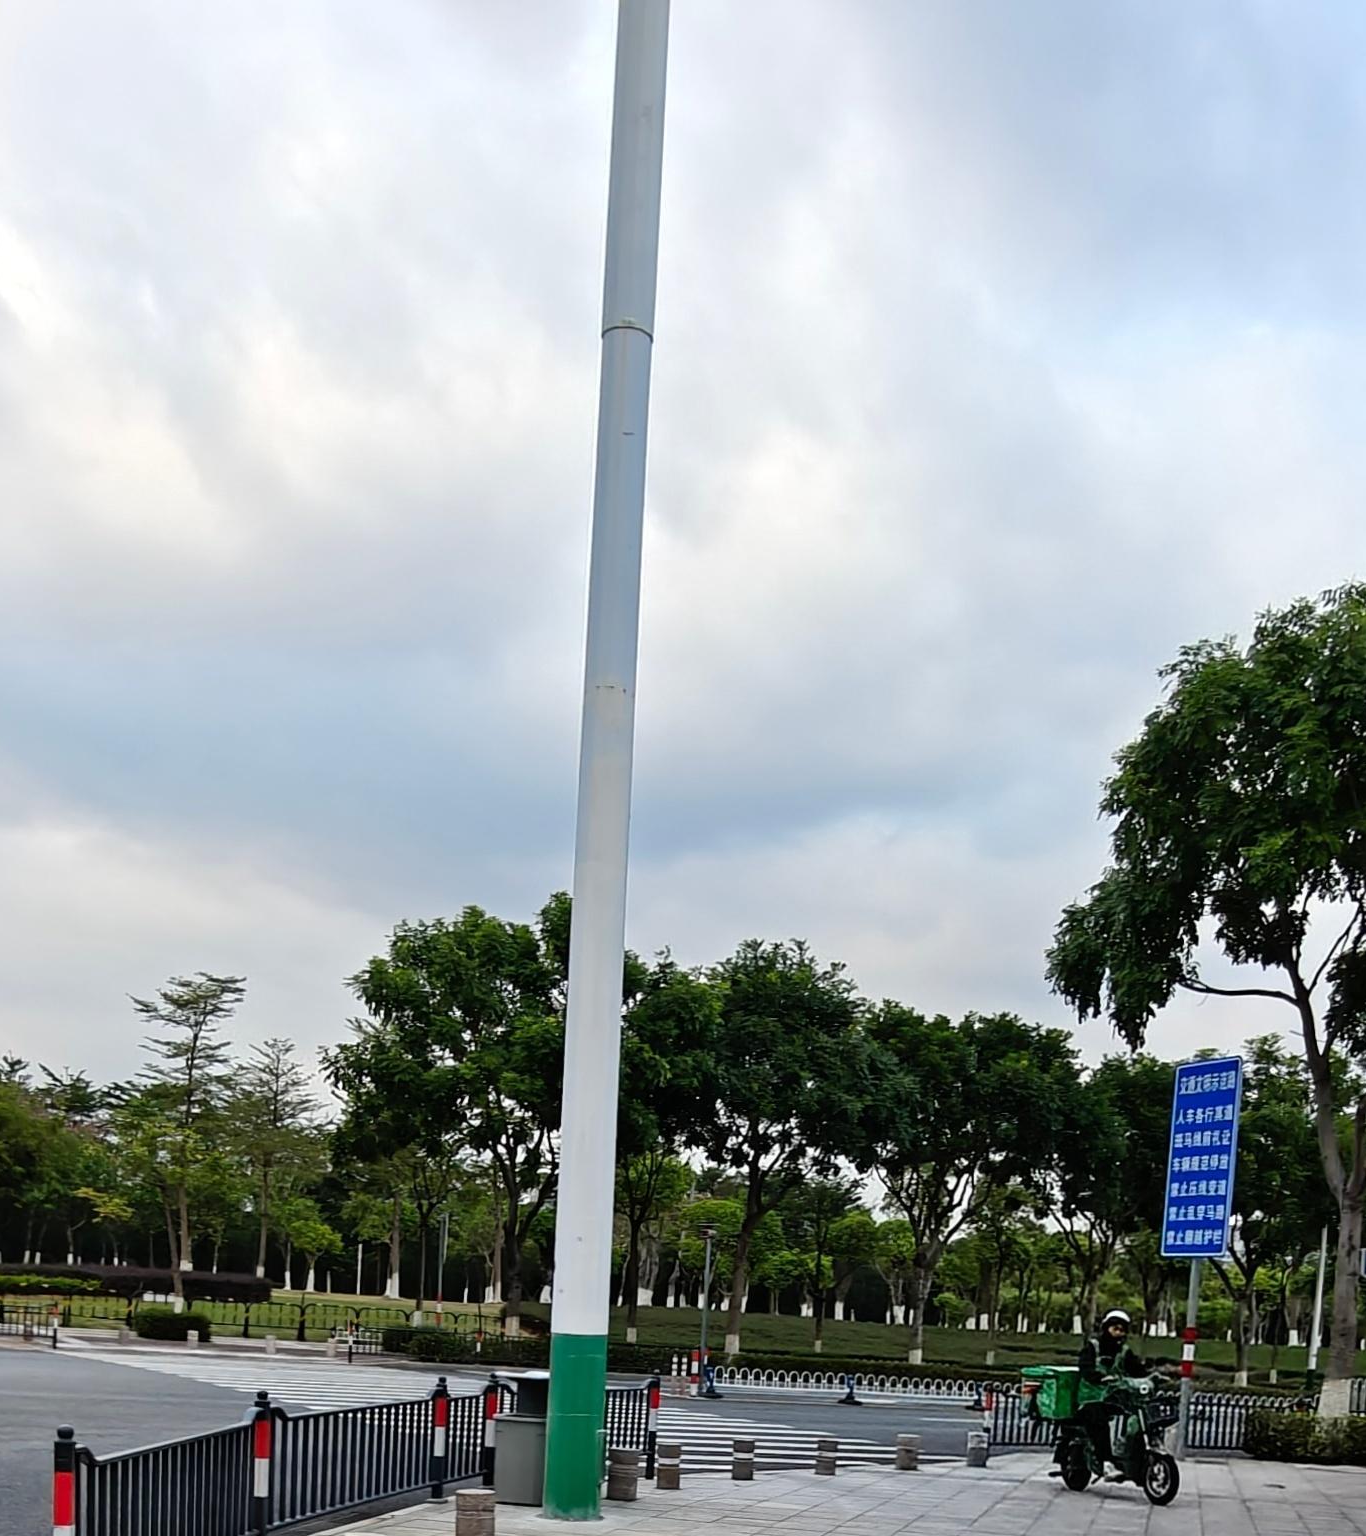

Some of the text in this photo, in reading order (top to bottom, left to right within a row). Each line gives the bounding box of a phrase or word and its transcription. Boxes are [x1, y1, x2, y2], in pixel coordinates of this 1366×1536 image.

[1173, 1129, 1231, 1148] 斑马线前礼让
